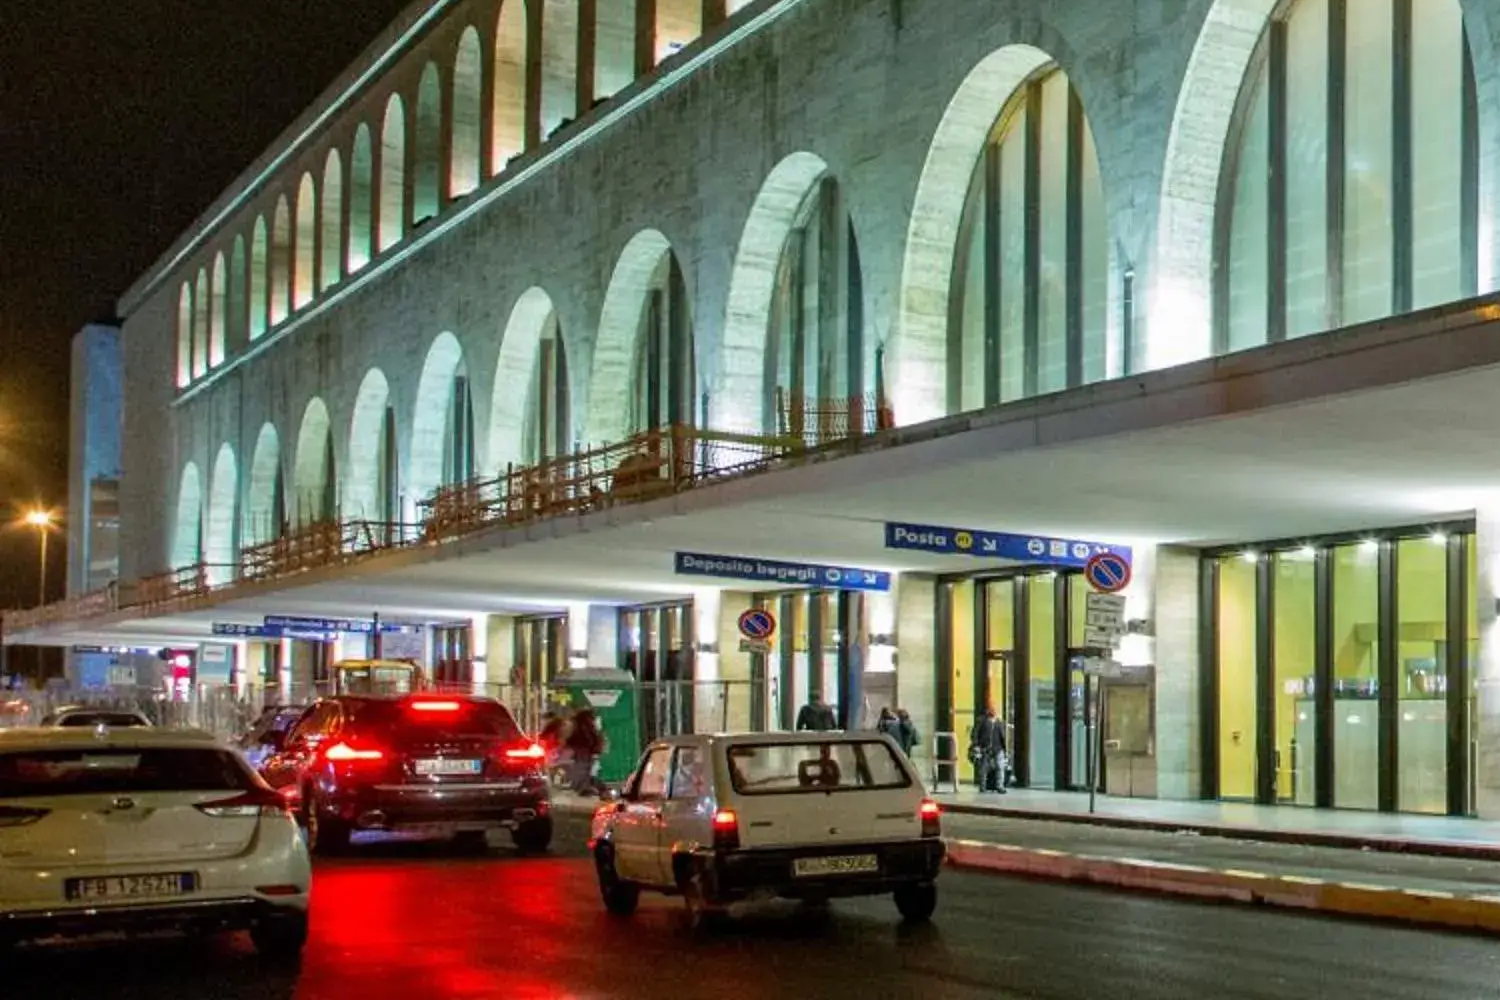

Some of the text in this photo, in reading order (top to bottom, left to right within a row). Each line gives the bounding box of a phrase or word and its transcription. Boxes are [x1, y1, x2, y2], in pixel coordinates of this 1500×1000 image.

[894, 527, 947, 546] Posta
[683, 555, 817, 580] Deposito bagagli
